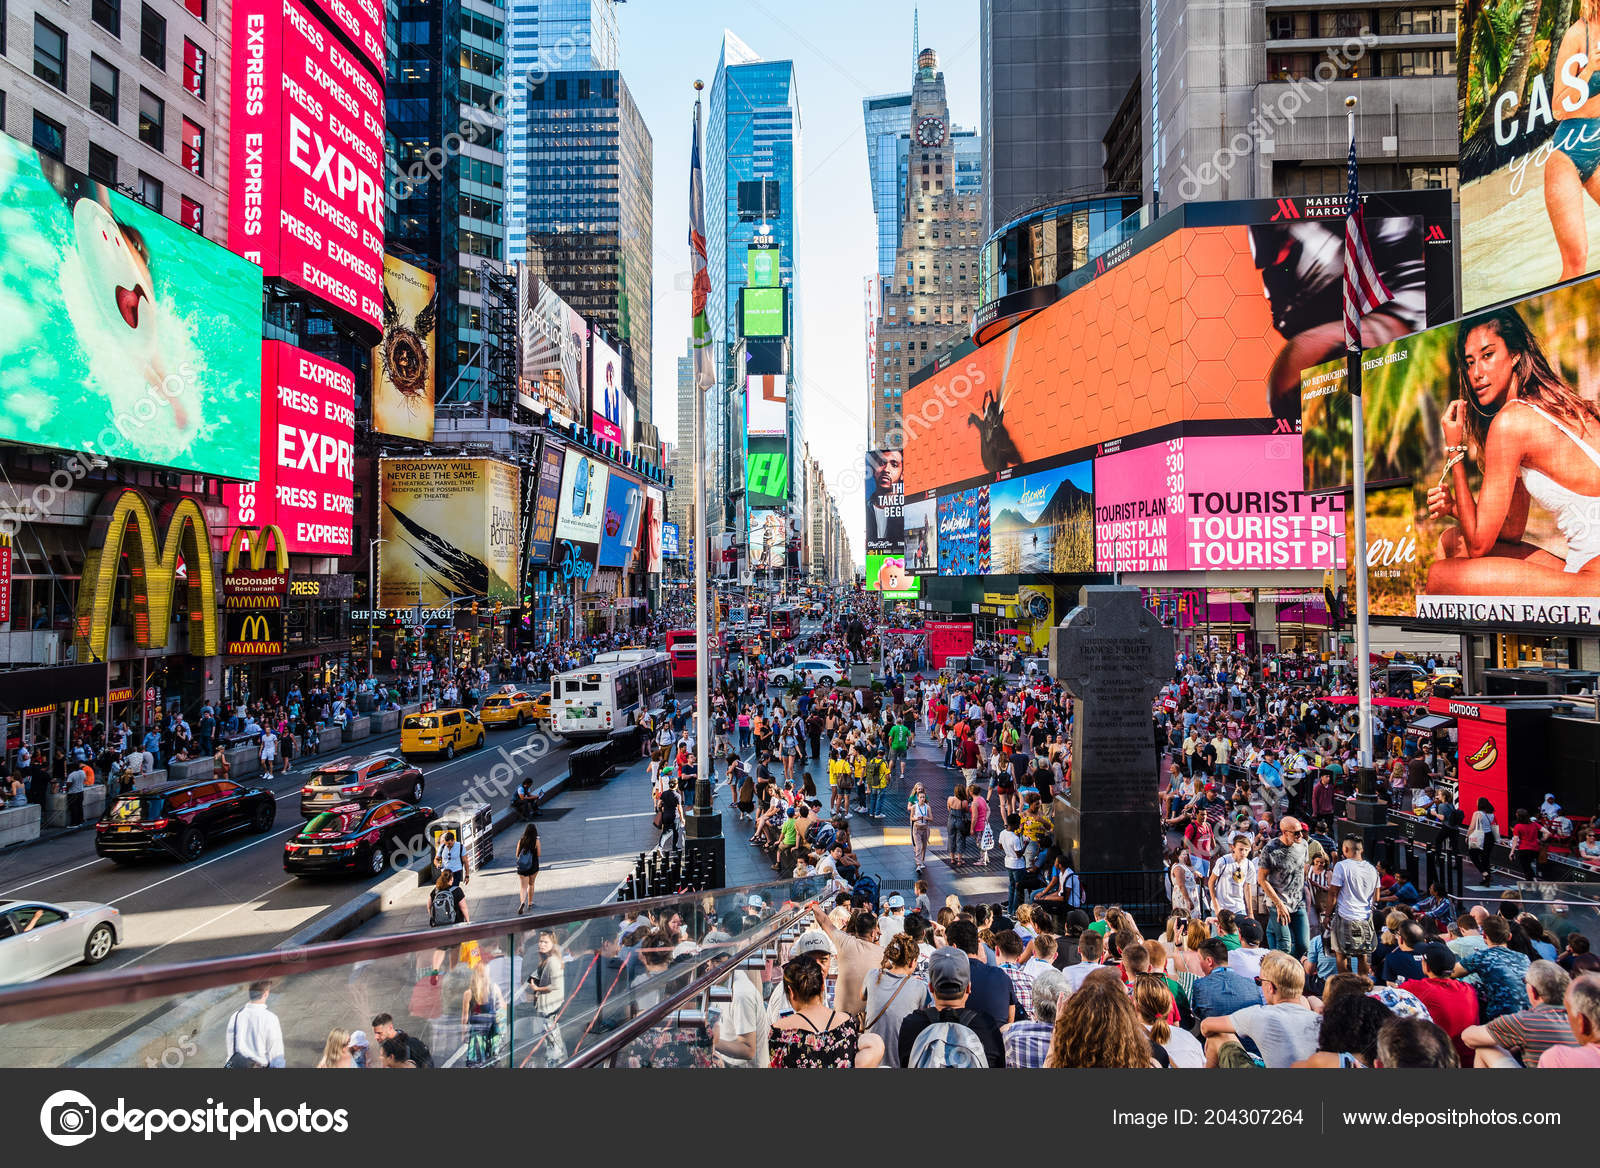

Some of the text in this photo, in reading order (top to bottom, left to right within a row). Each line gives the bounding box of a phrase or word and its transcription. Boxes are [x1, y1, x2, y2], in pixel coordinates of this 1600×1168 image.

[247, 14, 264, 116] EXPRESS
[330, 45, 378, 106] EXPRESS
[305, 56, 359, 118] EXPRESS
[282, 72, 323, 122] PRESS
[329, 113, 377, 169] EXPRESS
[244, 133, 262, 236] EXPRESS
[1306, 195, 1369, 206] MARRIT
[304, 187, 358, 239] EXPRESS
[280, 209, 376, 285] PRESS EXPRESS
[1106, 238, 1134, 259] MARRIOTT
[1106, 249, 1131, 269] MARQUIS
[303, 261, 357, 308] EXPRESS
[977, 300, 1001, 316] MARRIOTT
[977, 310, 998, 325] MARQUIS
[1362, 350, 1408, 371] THESE GIRLS!
[300, 358, 351, 396] EXPRESS
[450, 463, 473, 471] WILL
[1166, 453, 1184, 473] $30
[387, 471, 481, 480] NEVER BE THE SAME.
[1166, 473, 1185, 493] $30
[1096, 497, 1167, 524] TOURIST PLAN
[1167, 494, 1185, 514] $30
[1188, 490, 1304, 514] TOURIST
[492, 505, 516, 529] HARRY
[297, 522, 349, 546] EXPRESS
[490, 525, 518, 546] POTTER
[1096, 517, 1167, 542] TOURIST PLAN
[1188, 516, 1305, 540] TOURIST
[1096, 538, 1167, 559] TOURIST PLAN
[1189, 541, 1306, 565] TOURIST
[225, 577, 285, 586] McDonald's
[1374, 570, 1401, 578] AERIE.COM
[290, 581, 320, 596] PRESS
[351, 610, 455, 620] GIFTS LUGAGE
[1418, 602, 1592, 625] AMERICAN EAGLE
[1449, 703, 1480, 717] HOTDOGS
